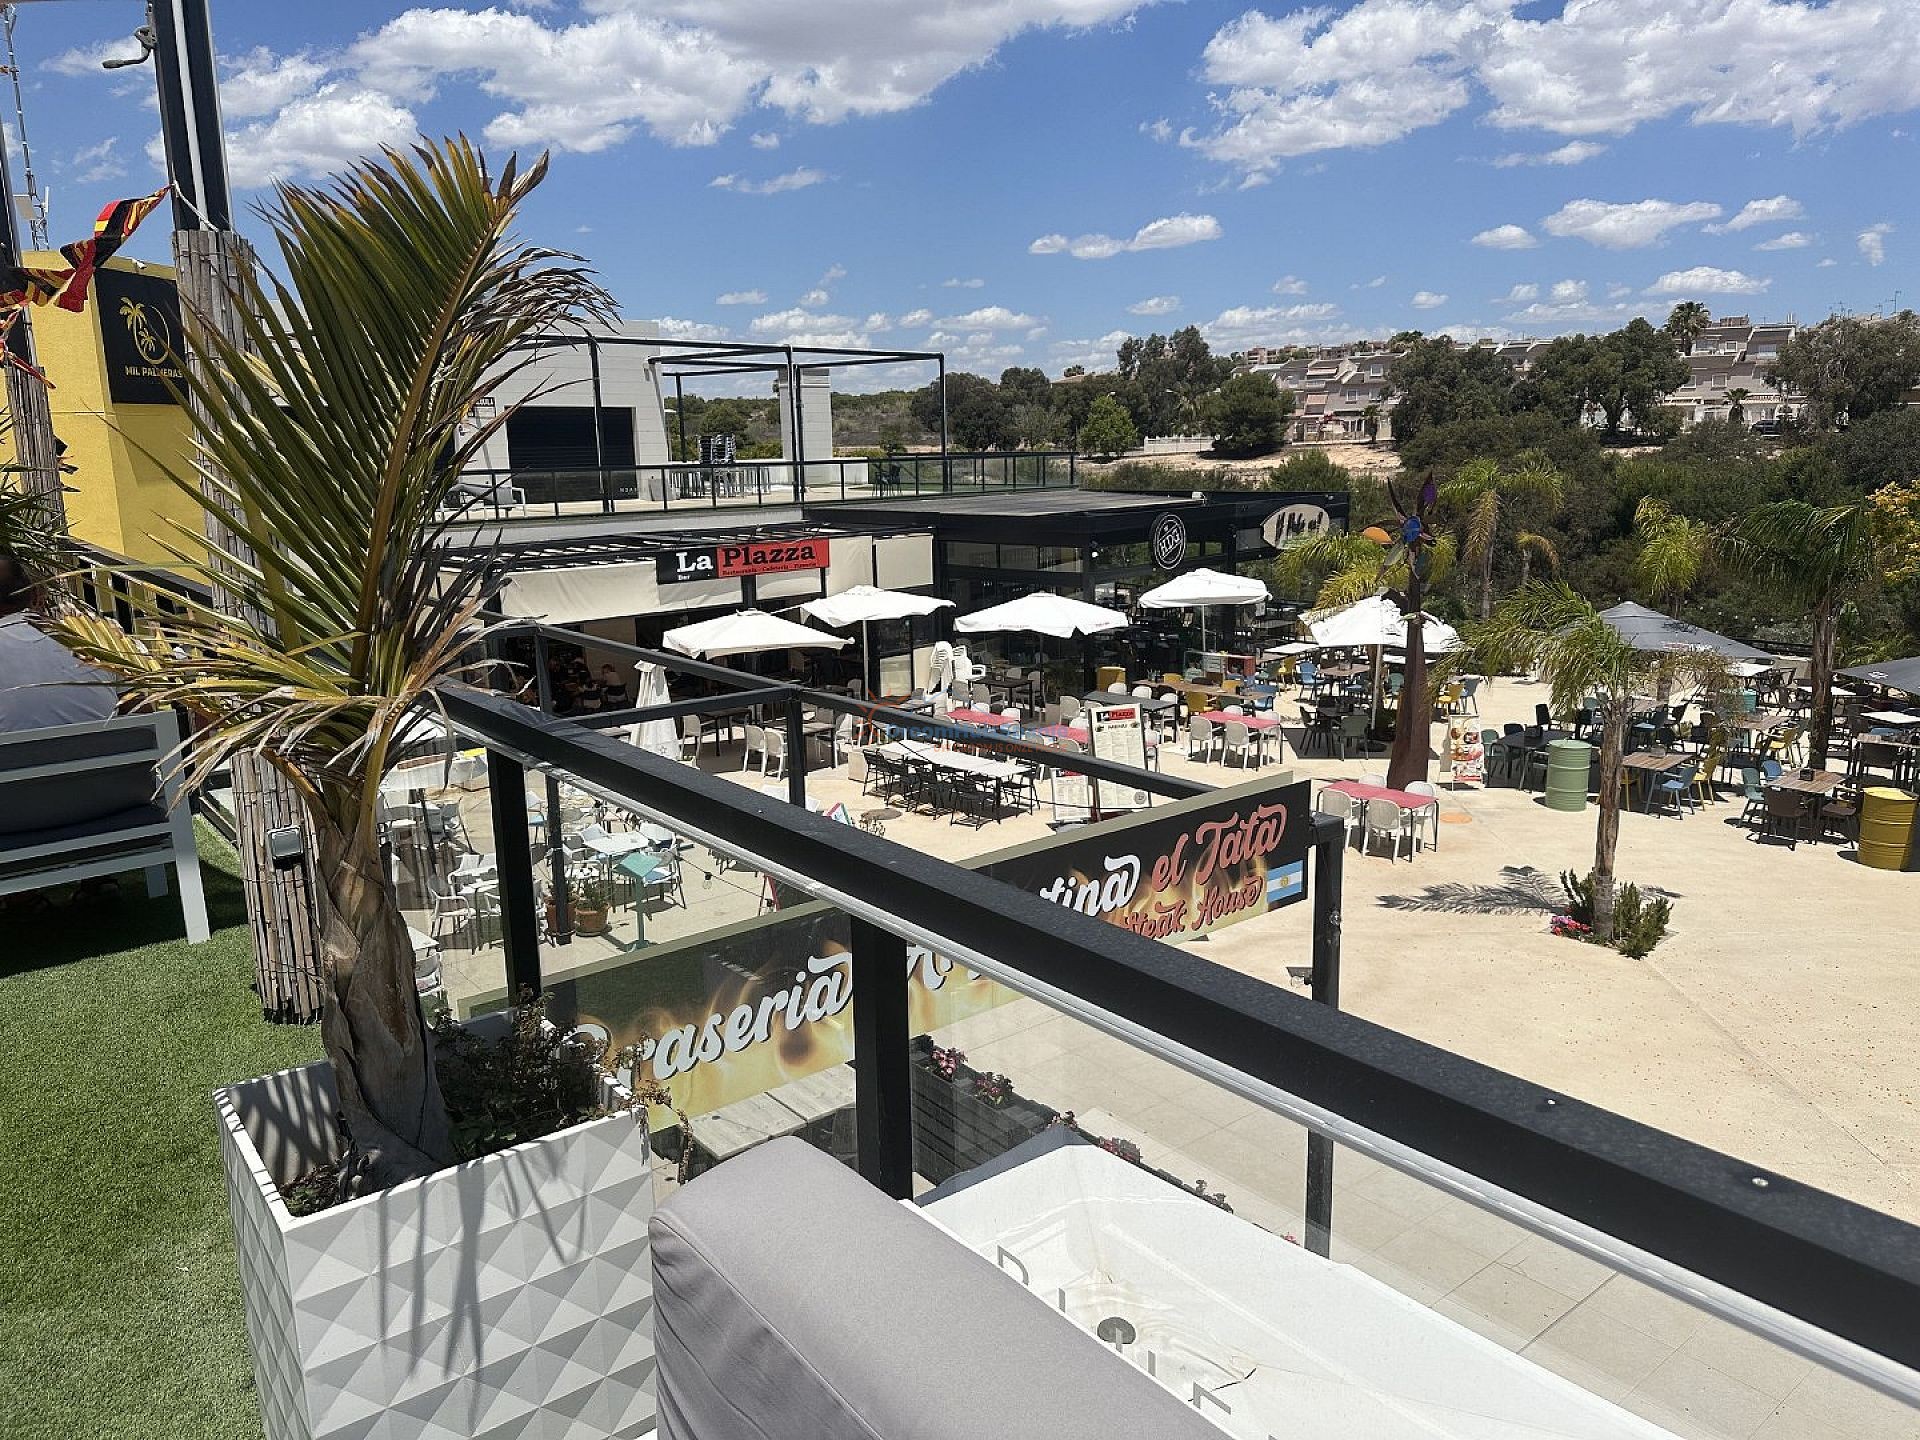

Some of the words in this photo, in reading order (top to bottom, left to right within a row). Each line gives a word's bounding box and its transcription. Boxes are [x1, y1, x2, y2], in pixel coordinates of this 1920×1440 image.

[125, 365, 140, 376] MIL
[675, 551, 714, 574] La
[722, 545, 816, 568] Plazza
[1151, 832, 1189, 893] el
[1195, 803, 1288, 886] Tata
[1191, 875, 1264, 931] House
